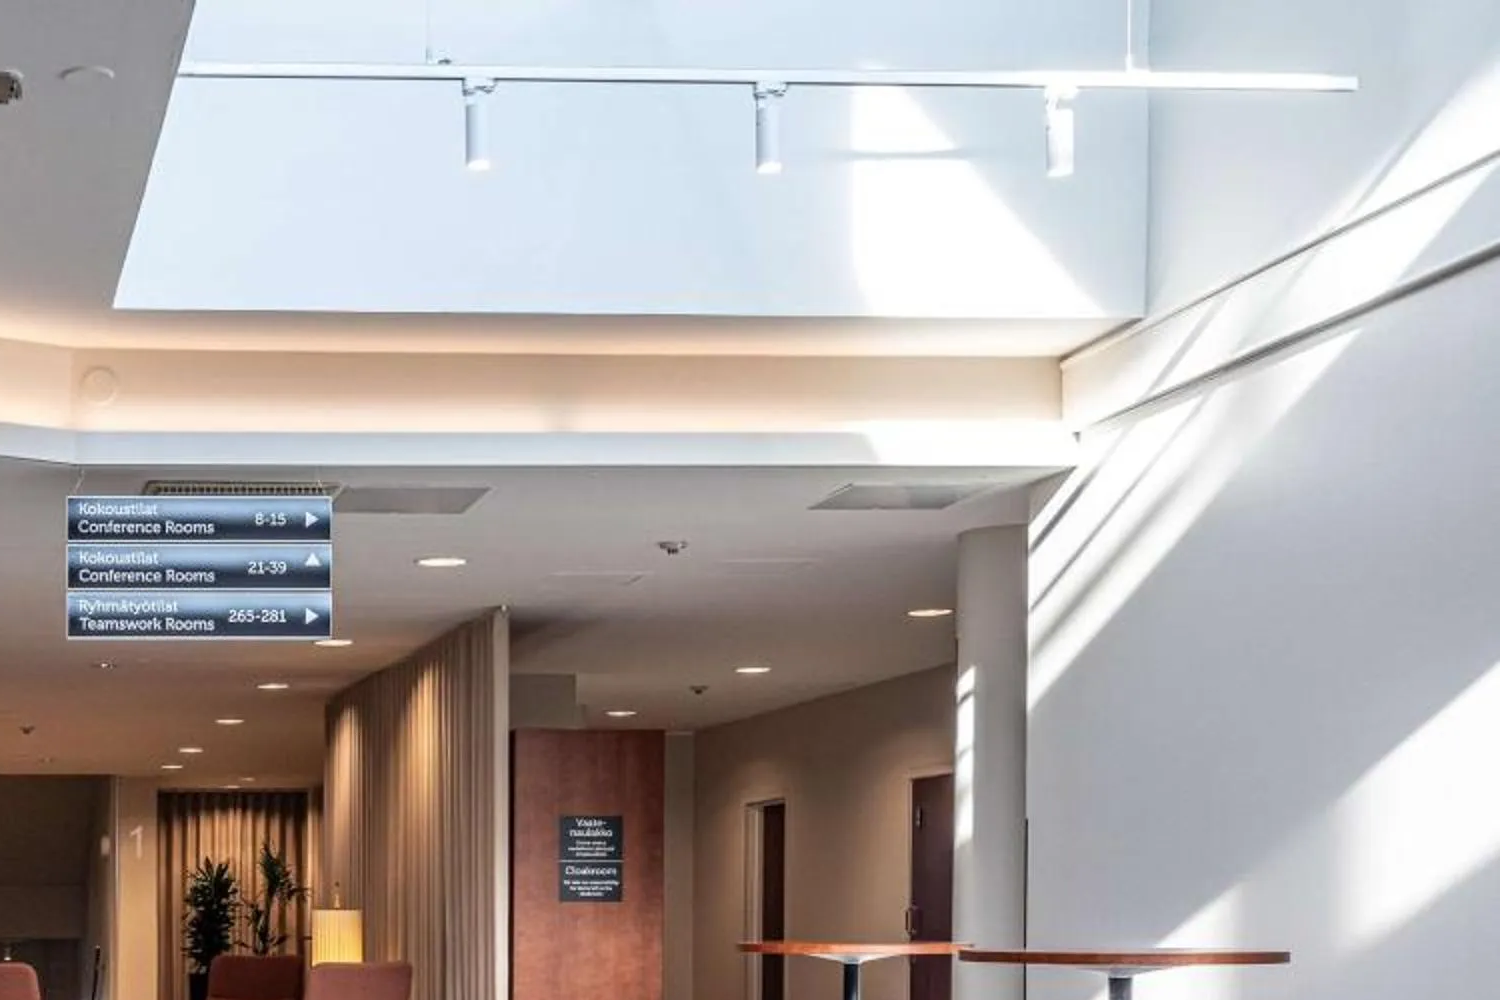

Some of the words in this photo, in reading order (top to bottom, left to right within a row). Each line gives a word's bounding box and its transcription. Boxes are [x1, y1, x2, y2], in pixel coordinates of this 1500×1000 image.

[78, 503, 158, 515] Kokoustilat
[78, 520, 161, 534] Conference
[165, 521, 215, 534] Rooms
[78, 551, 159, 563] Kokoustilat
[248, 562, 287, 574] 21-39
[79, 569, 161, 582] Conference
[166, 569, 215, 582] Rooms
[228, 610, 287, 623] 265-281
[165, 617, 215, 631] Rooms
